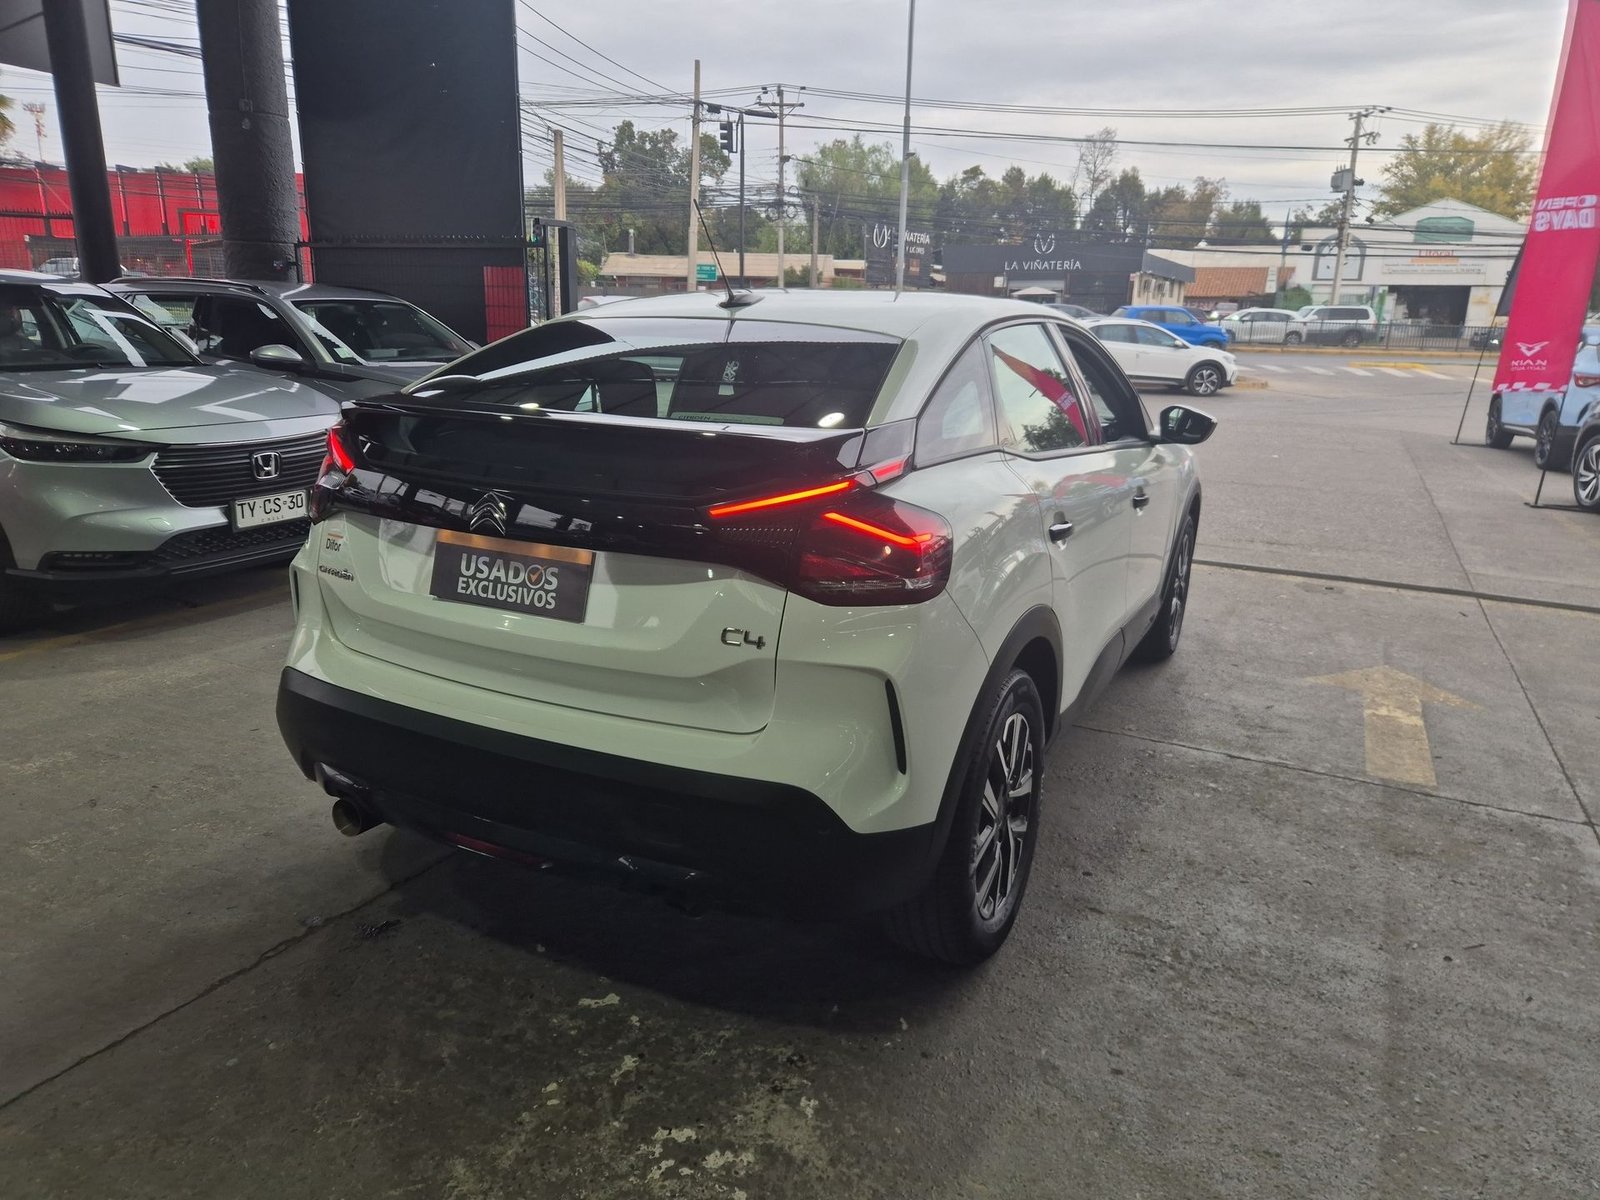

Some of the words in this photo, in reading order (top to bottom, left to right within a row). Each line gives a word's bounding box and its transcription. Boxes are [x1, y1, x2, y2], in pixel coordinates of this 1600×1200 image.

[1004, 260, 1018, 270] LA
[1022, 259, 1082, 270] VIÑATERÍA
[460, 553, 559, 590] USADOS
[457, 576, 557, 609] EXCLUSIVOS
[721, 627, 766, 650] C4
